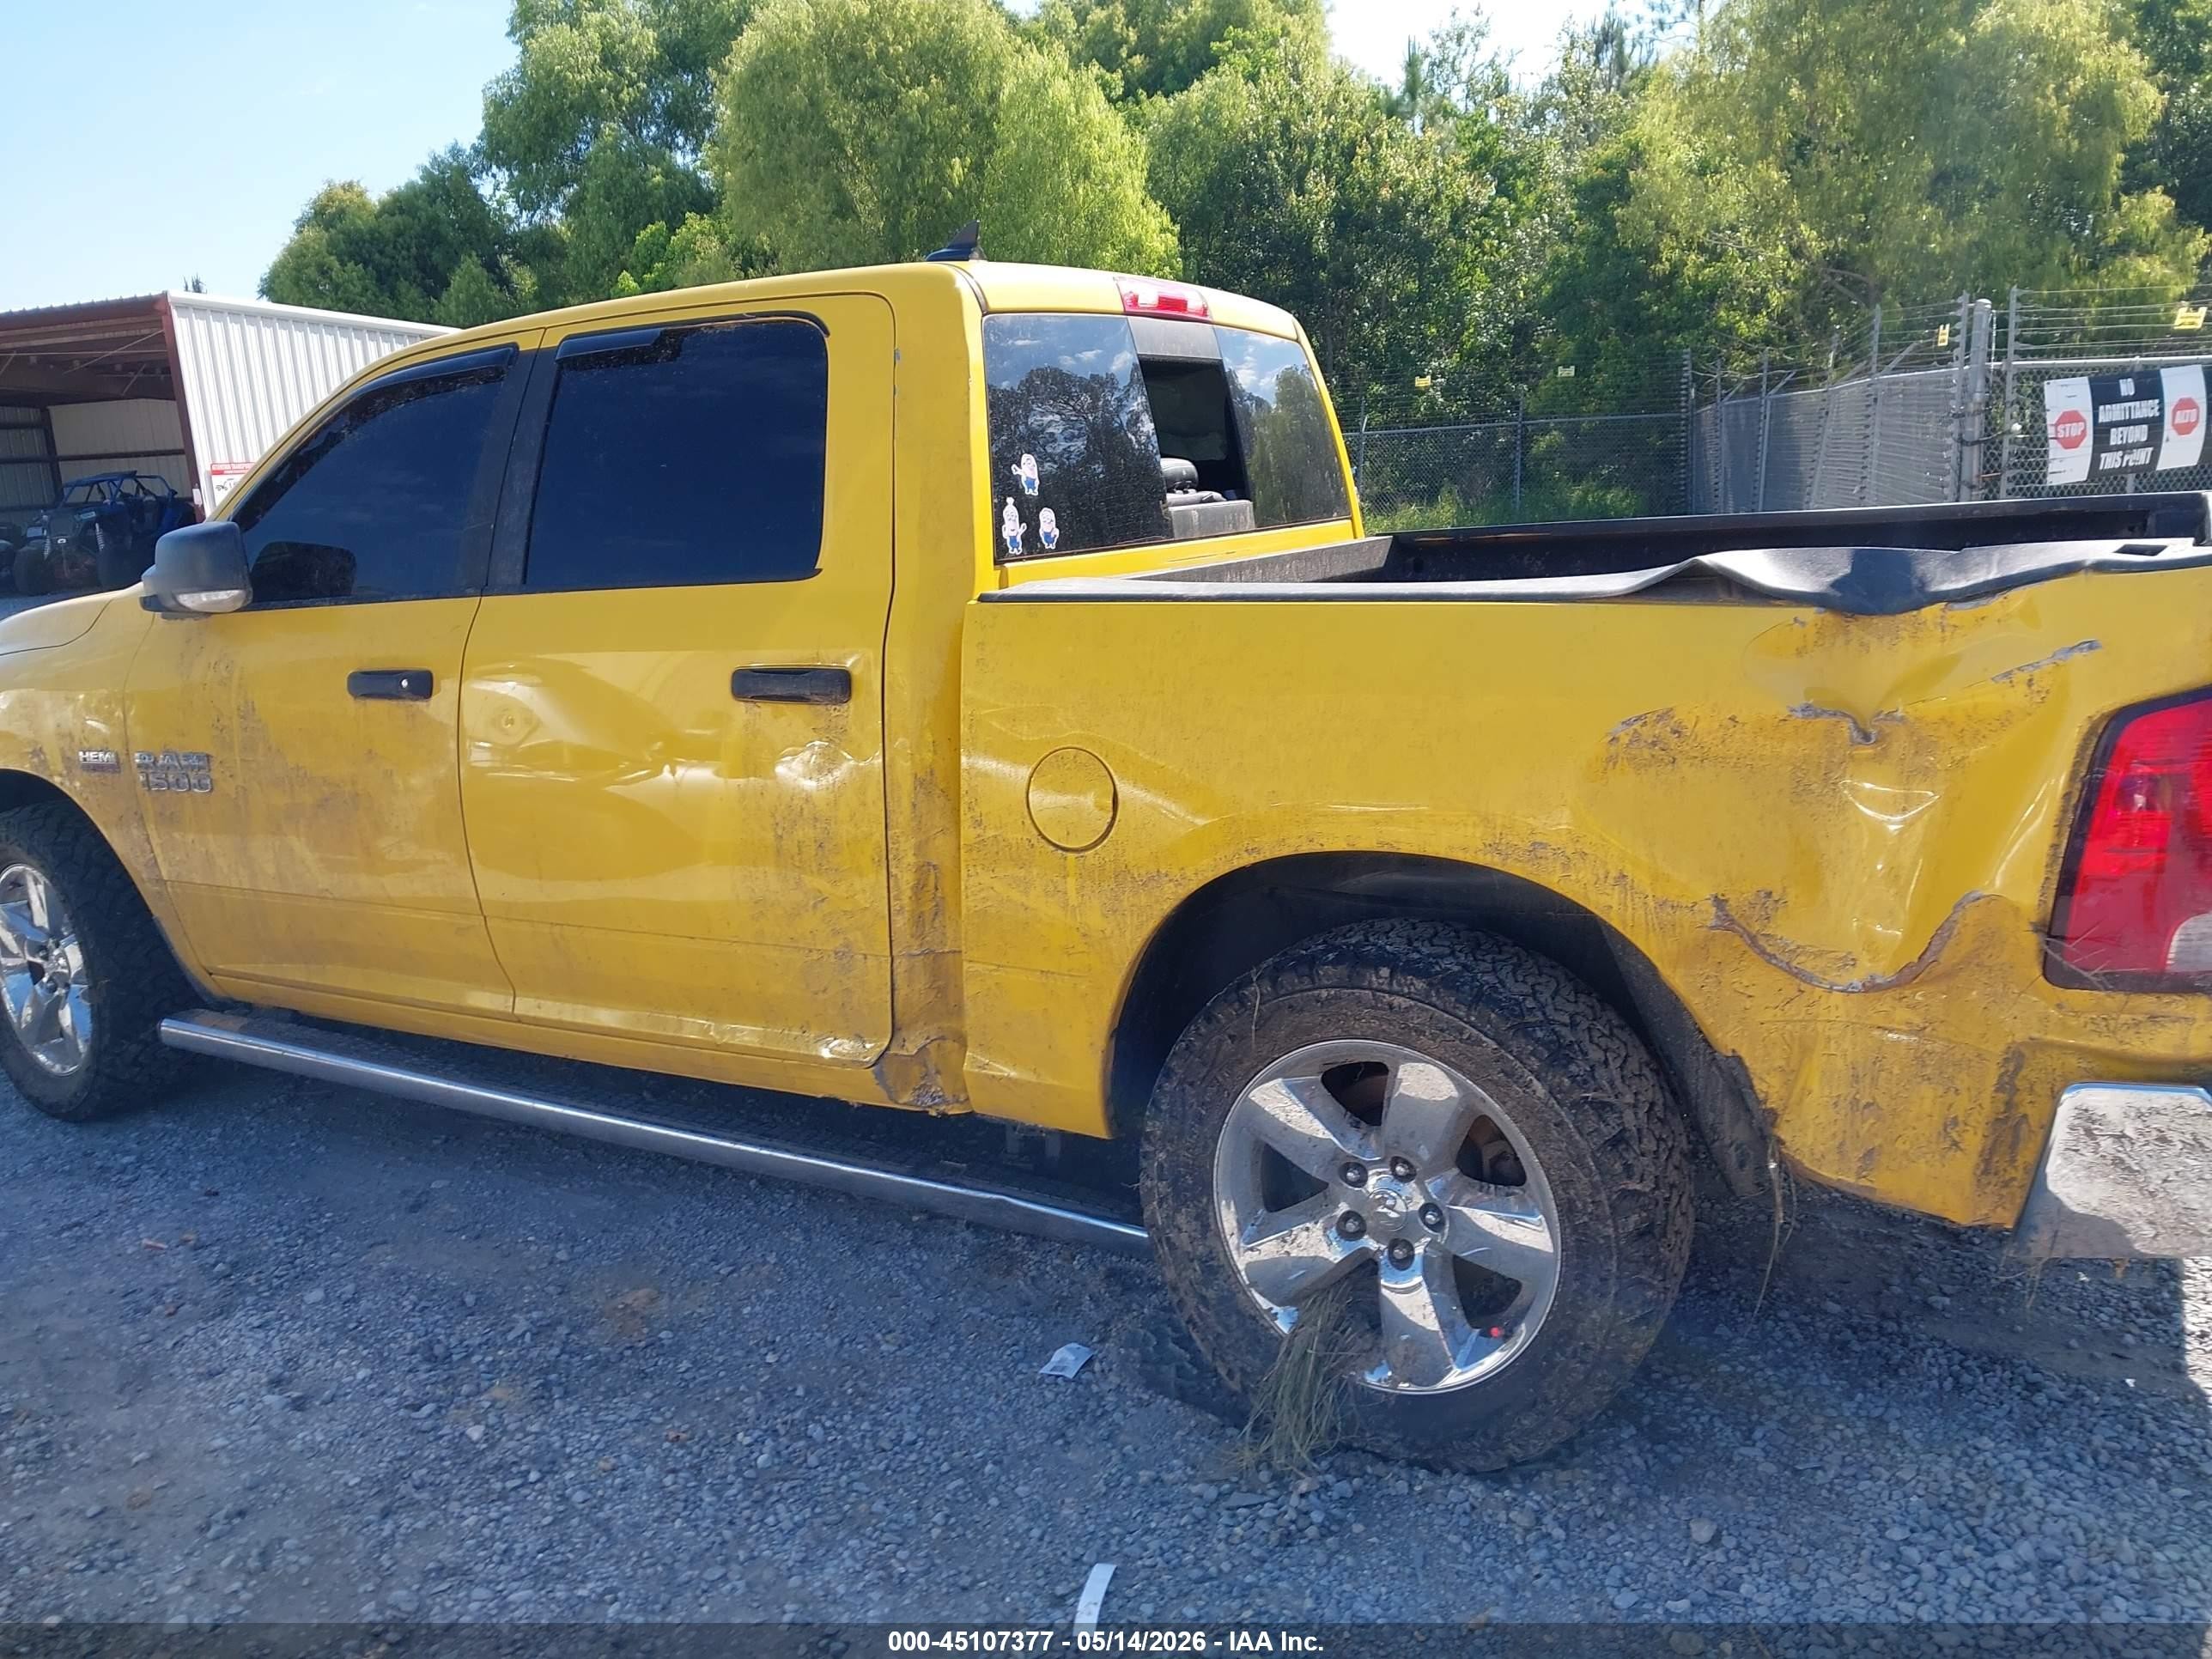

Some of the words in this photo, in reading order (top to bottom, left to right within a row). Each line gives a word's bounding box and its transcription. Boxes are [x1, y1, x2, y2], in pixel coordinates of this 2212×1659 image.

[2119, 378, 2135, 397] NO
[2098, 399, 2160, 423] ADMITTANCE
[2057, 422, 2085, 438] STOP
[2109, 424, 2148, 446] BEYOND
[2099, 452, 2124, 471] THIS
[2123, 447, 2154, 467] POINT
[139, 772, 214, 793] 1500
